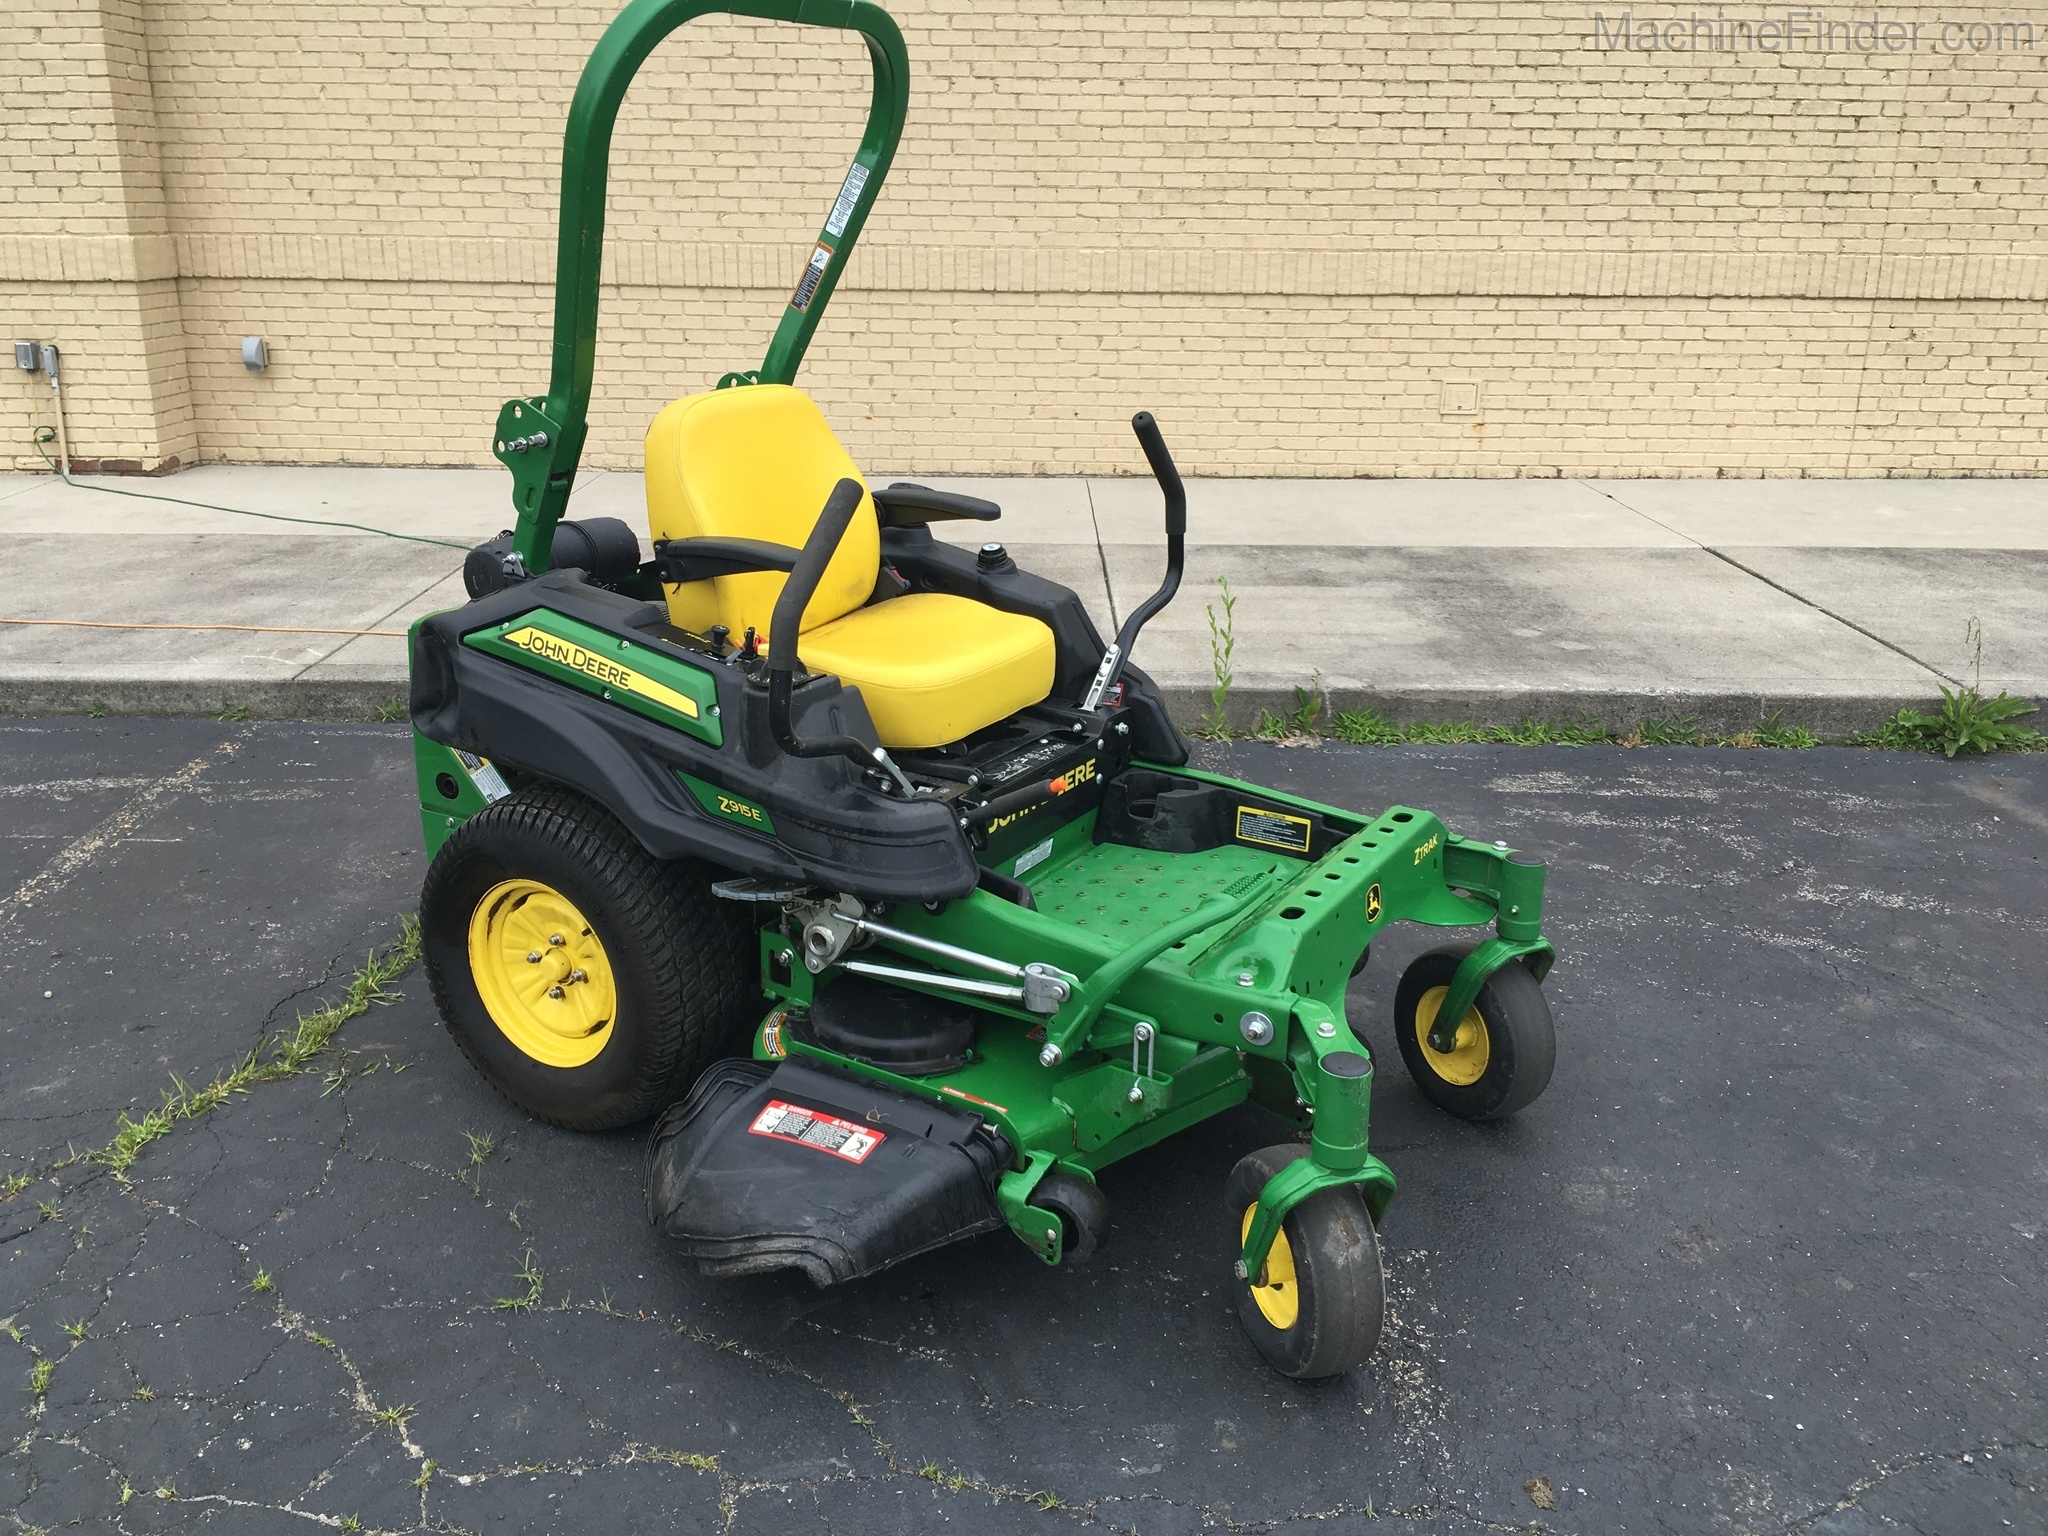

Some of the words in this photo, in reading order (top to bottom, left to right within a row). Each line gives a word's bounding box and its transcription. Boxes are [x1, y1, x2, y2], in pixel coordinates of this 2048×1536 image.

[522, 631, 570, 662] JOHN
[572, 648, 631, 688] DEERE
[717, 795, 762, 822] Z915E
[786, 1104, 814, 1117] DANGER
[839, 1120, 868, 1134] PELIGRO
